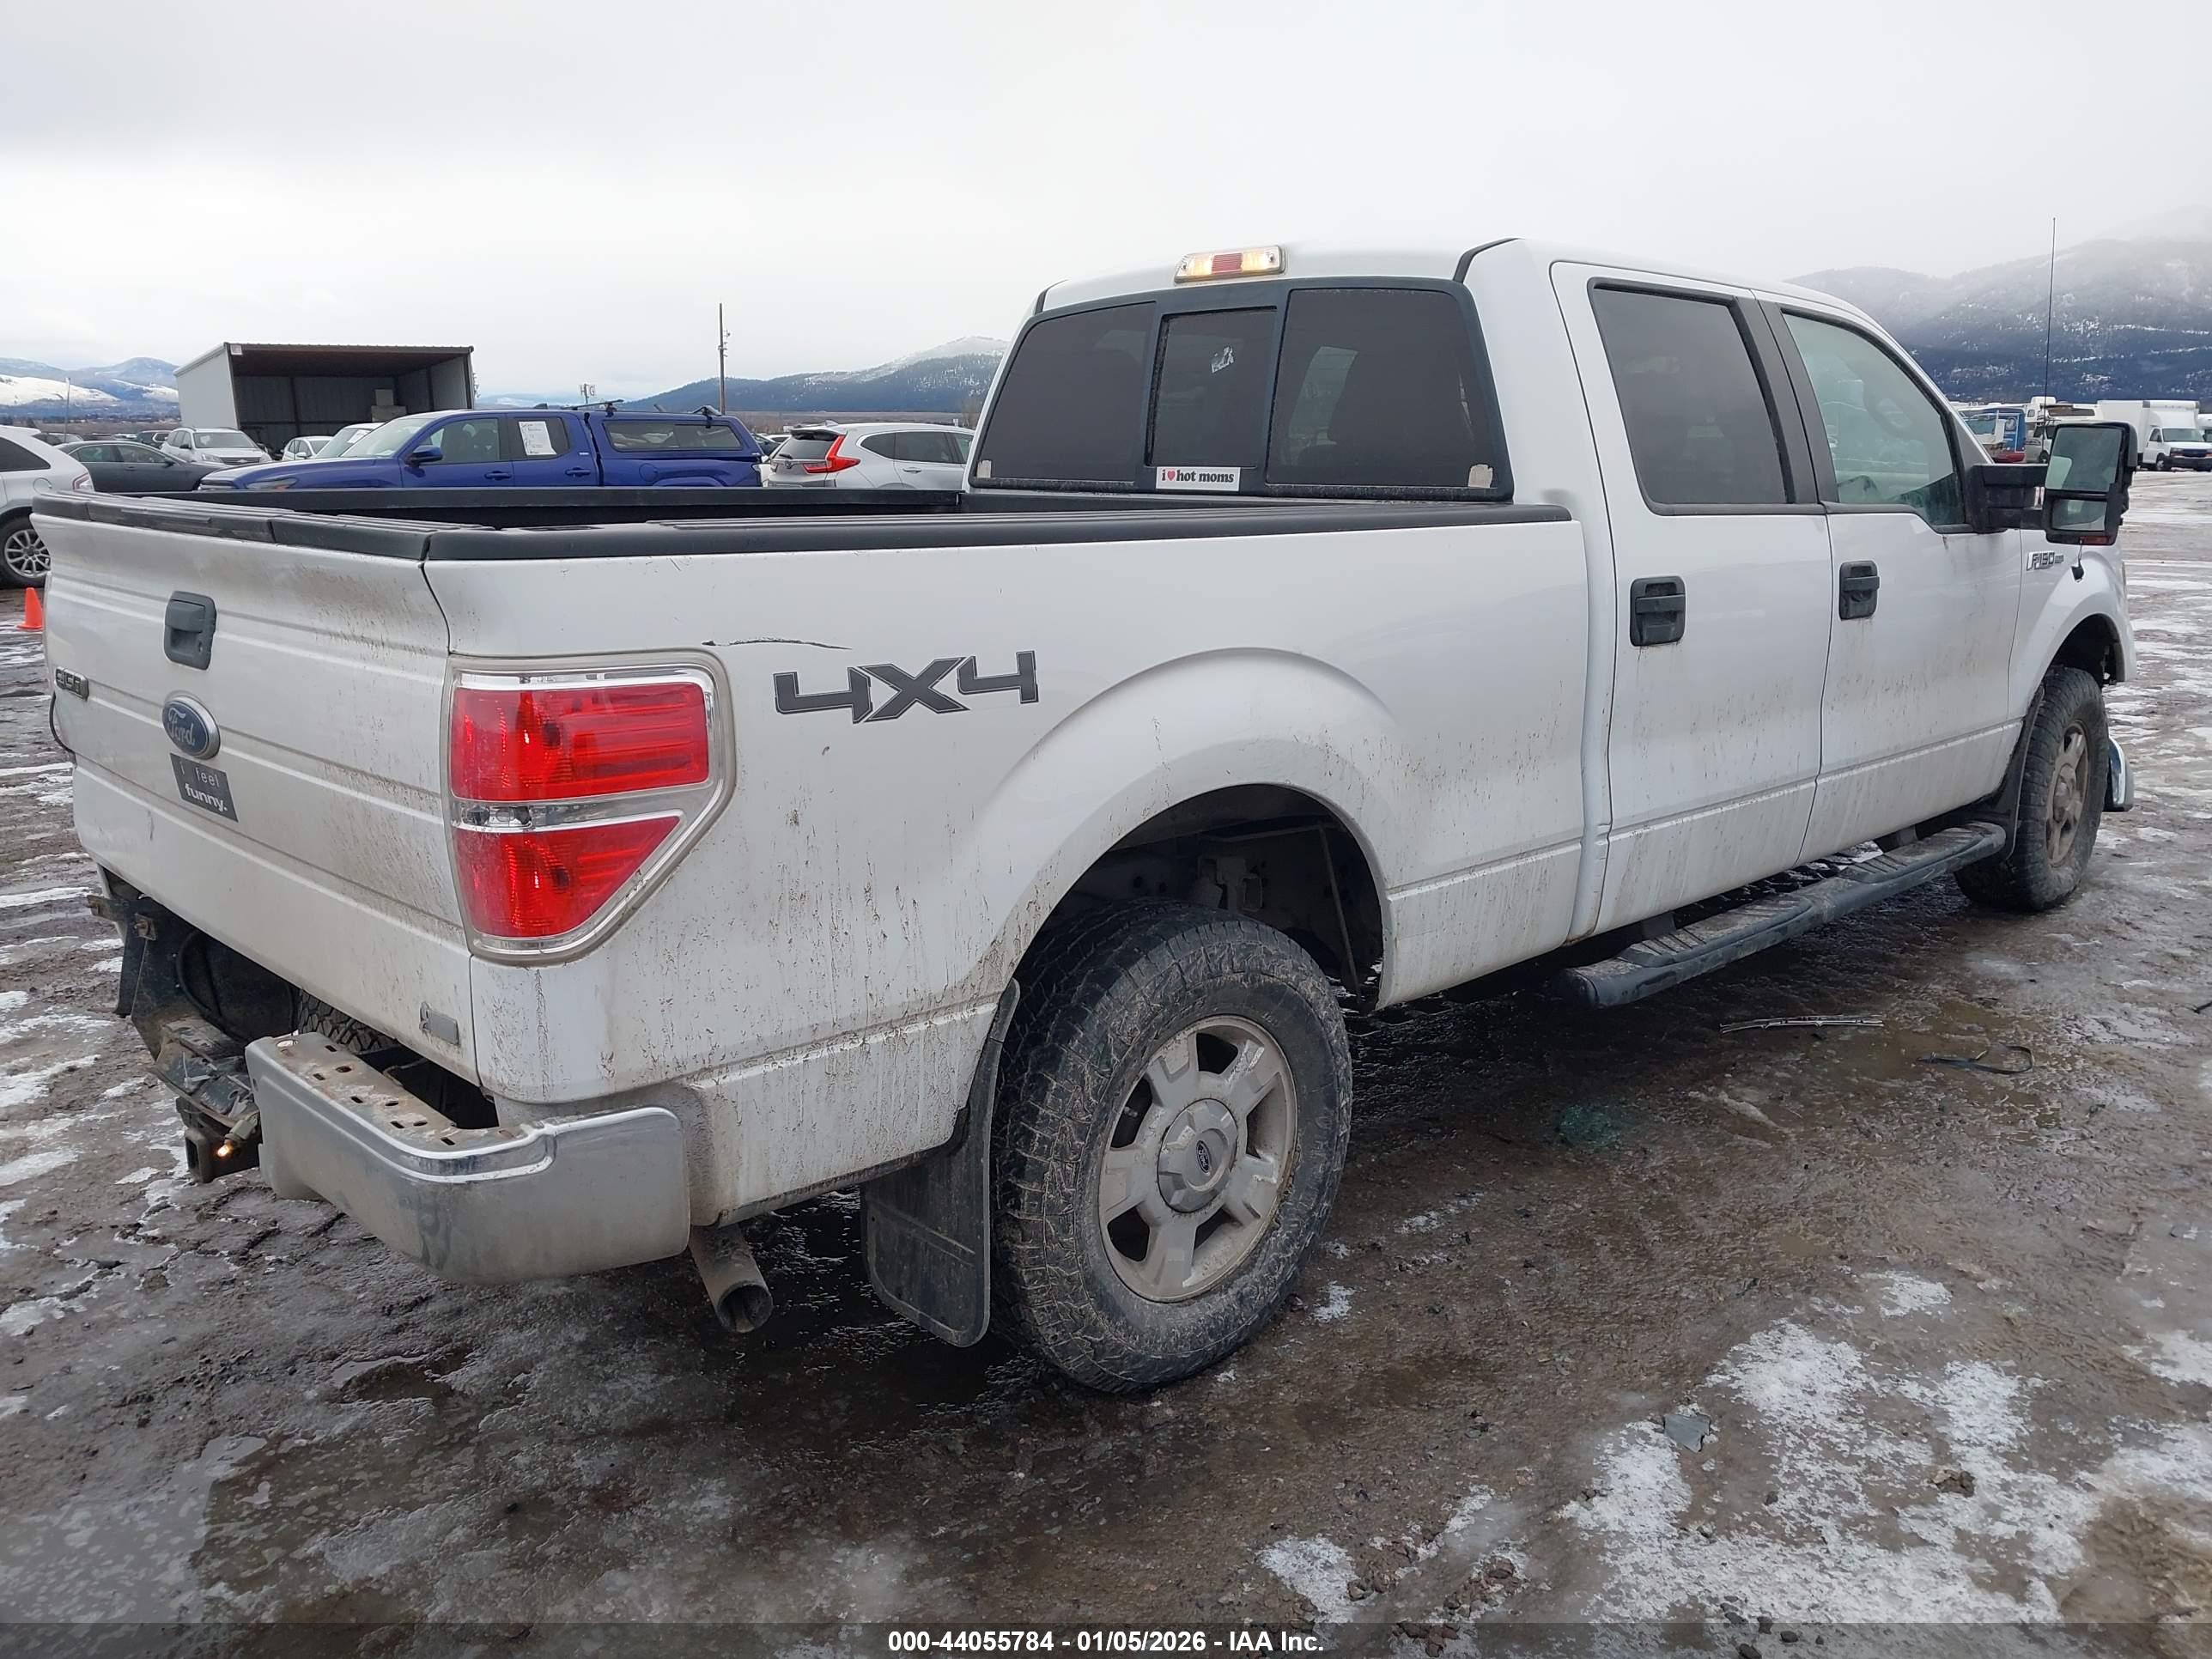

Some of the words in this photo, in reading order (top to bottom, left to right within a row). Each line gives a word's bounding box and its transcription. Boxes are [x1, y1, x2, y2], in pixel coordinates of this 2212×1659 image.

[1162, 469, 1167, 482] i
[1176, 469, 1196, 482] hot
[1199, 473, 1235, 483] moms
[167, 707, 196, 746] Ford
[195, 767, 220, 788] feel
[185, 782, 228, 812] funny.
